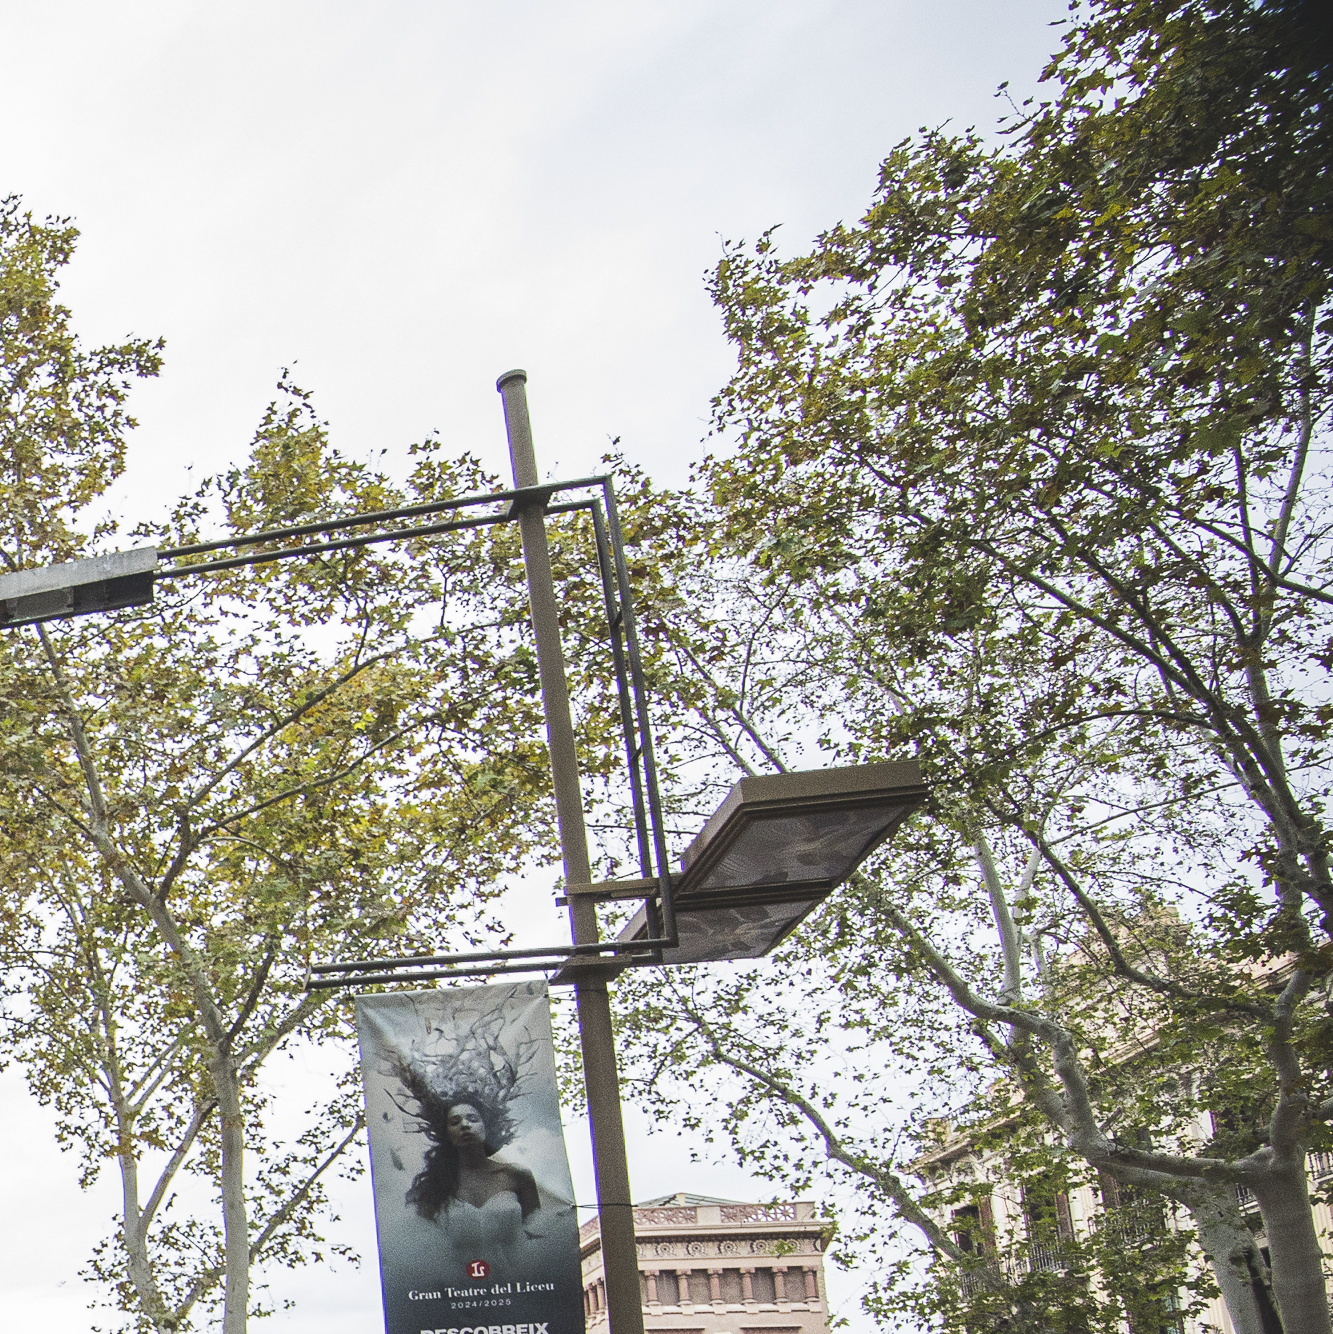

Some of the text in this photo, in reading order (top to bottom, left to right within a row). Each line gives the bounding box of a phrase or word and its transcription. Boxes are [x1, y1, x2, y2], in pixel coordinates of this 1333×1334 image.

[408, 1281, 555, 1301] Gran Teatre del Liceu
[451, 1299, 511, 1309] 2024/2025
